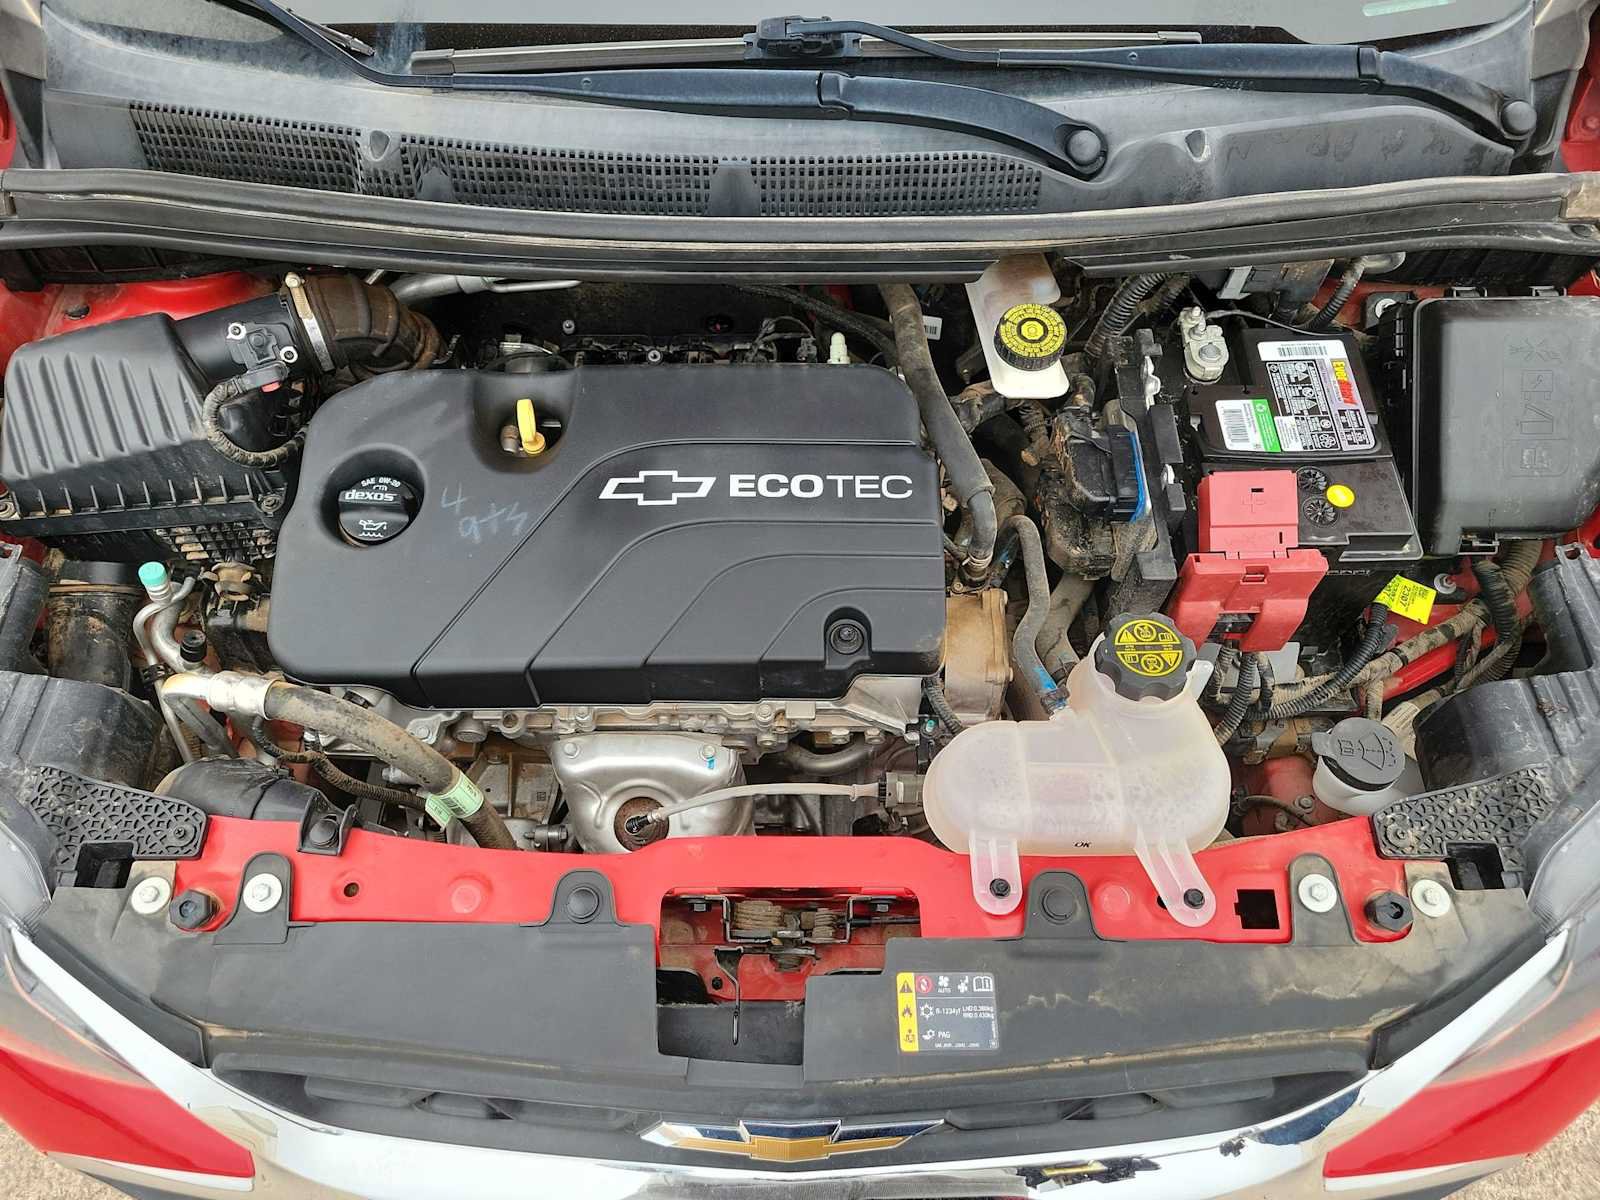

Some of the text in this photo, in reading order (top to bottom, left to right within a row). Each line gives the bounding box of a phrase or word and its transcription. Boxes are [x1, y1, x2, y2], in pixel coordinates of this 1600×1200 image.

[361, 477, 376, 487] SAE
[729, 474, 913, 499] ECOTEC
[345, 489, 398, 502] dexos
